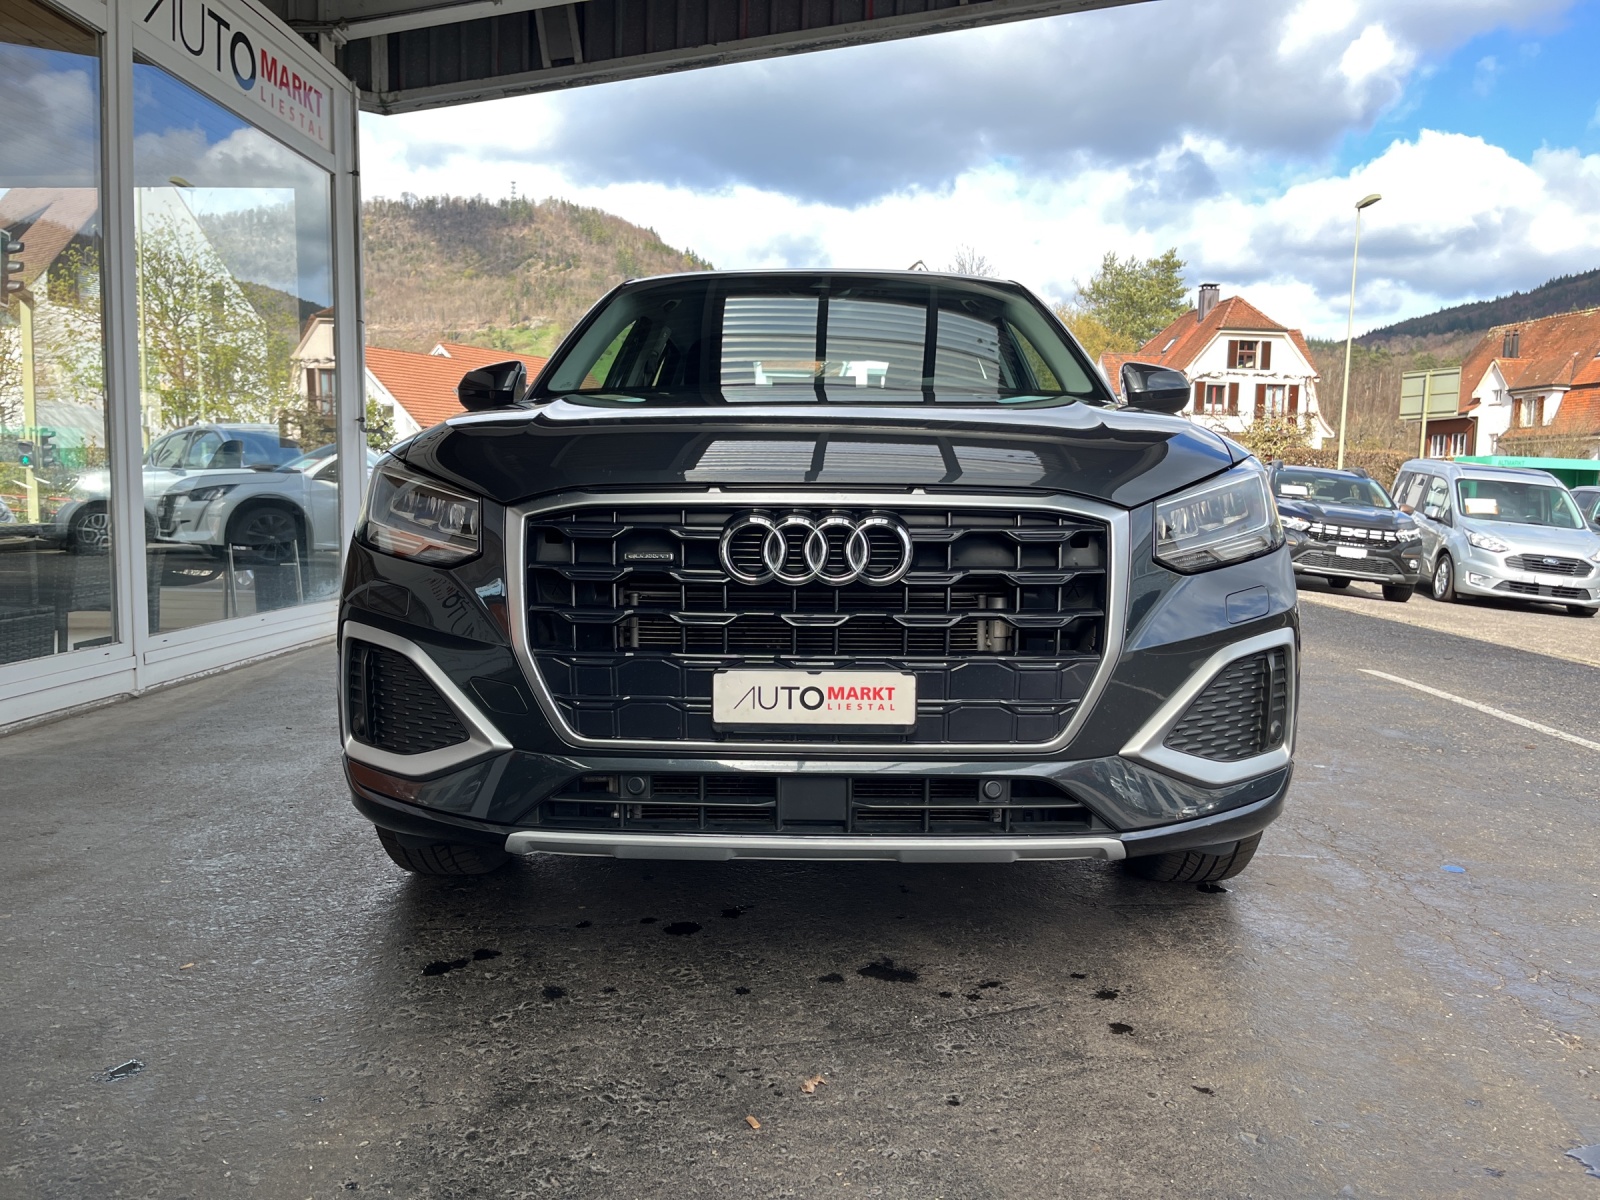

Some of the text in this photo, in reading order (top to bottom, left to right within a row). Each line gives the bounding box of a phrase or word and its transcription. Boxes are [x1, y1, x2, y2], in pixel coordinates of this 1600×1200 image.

[260, 47, 323, 118] MARKT
[260, 86, 324, 141] LIESTAL
[733, 686, 896, 711] AUTO MARKT
[827, 703, 896, 711] LIESTAL
